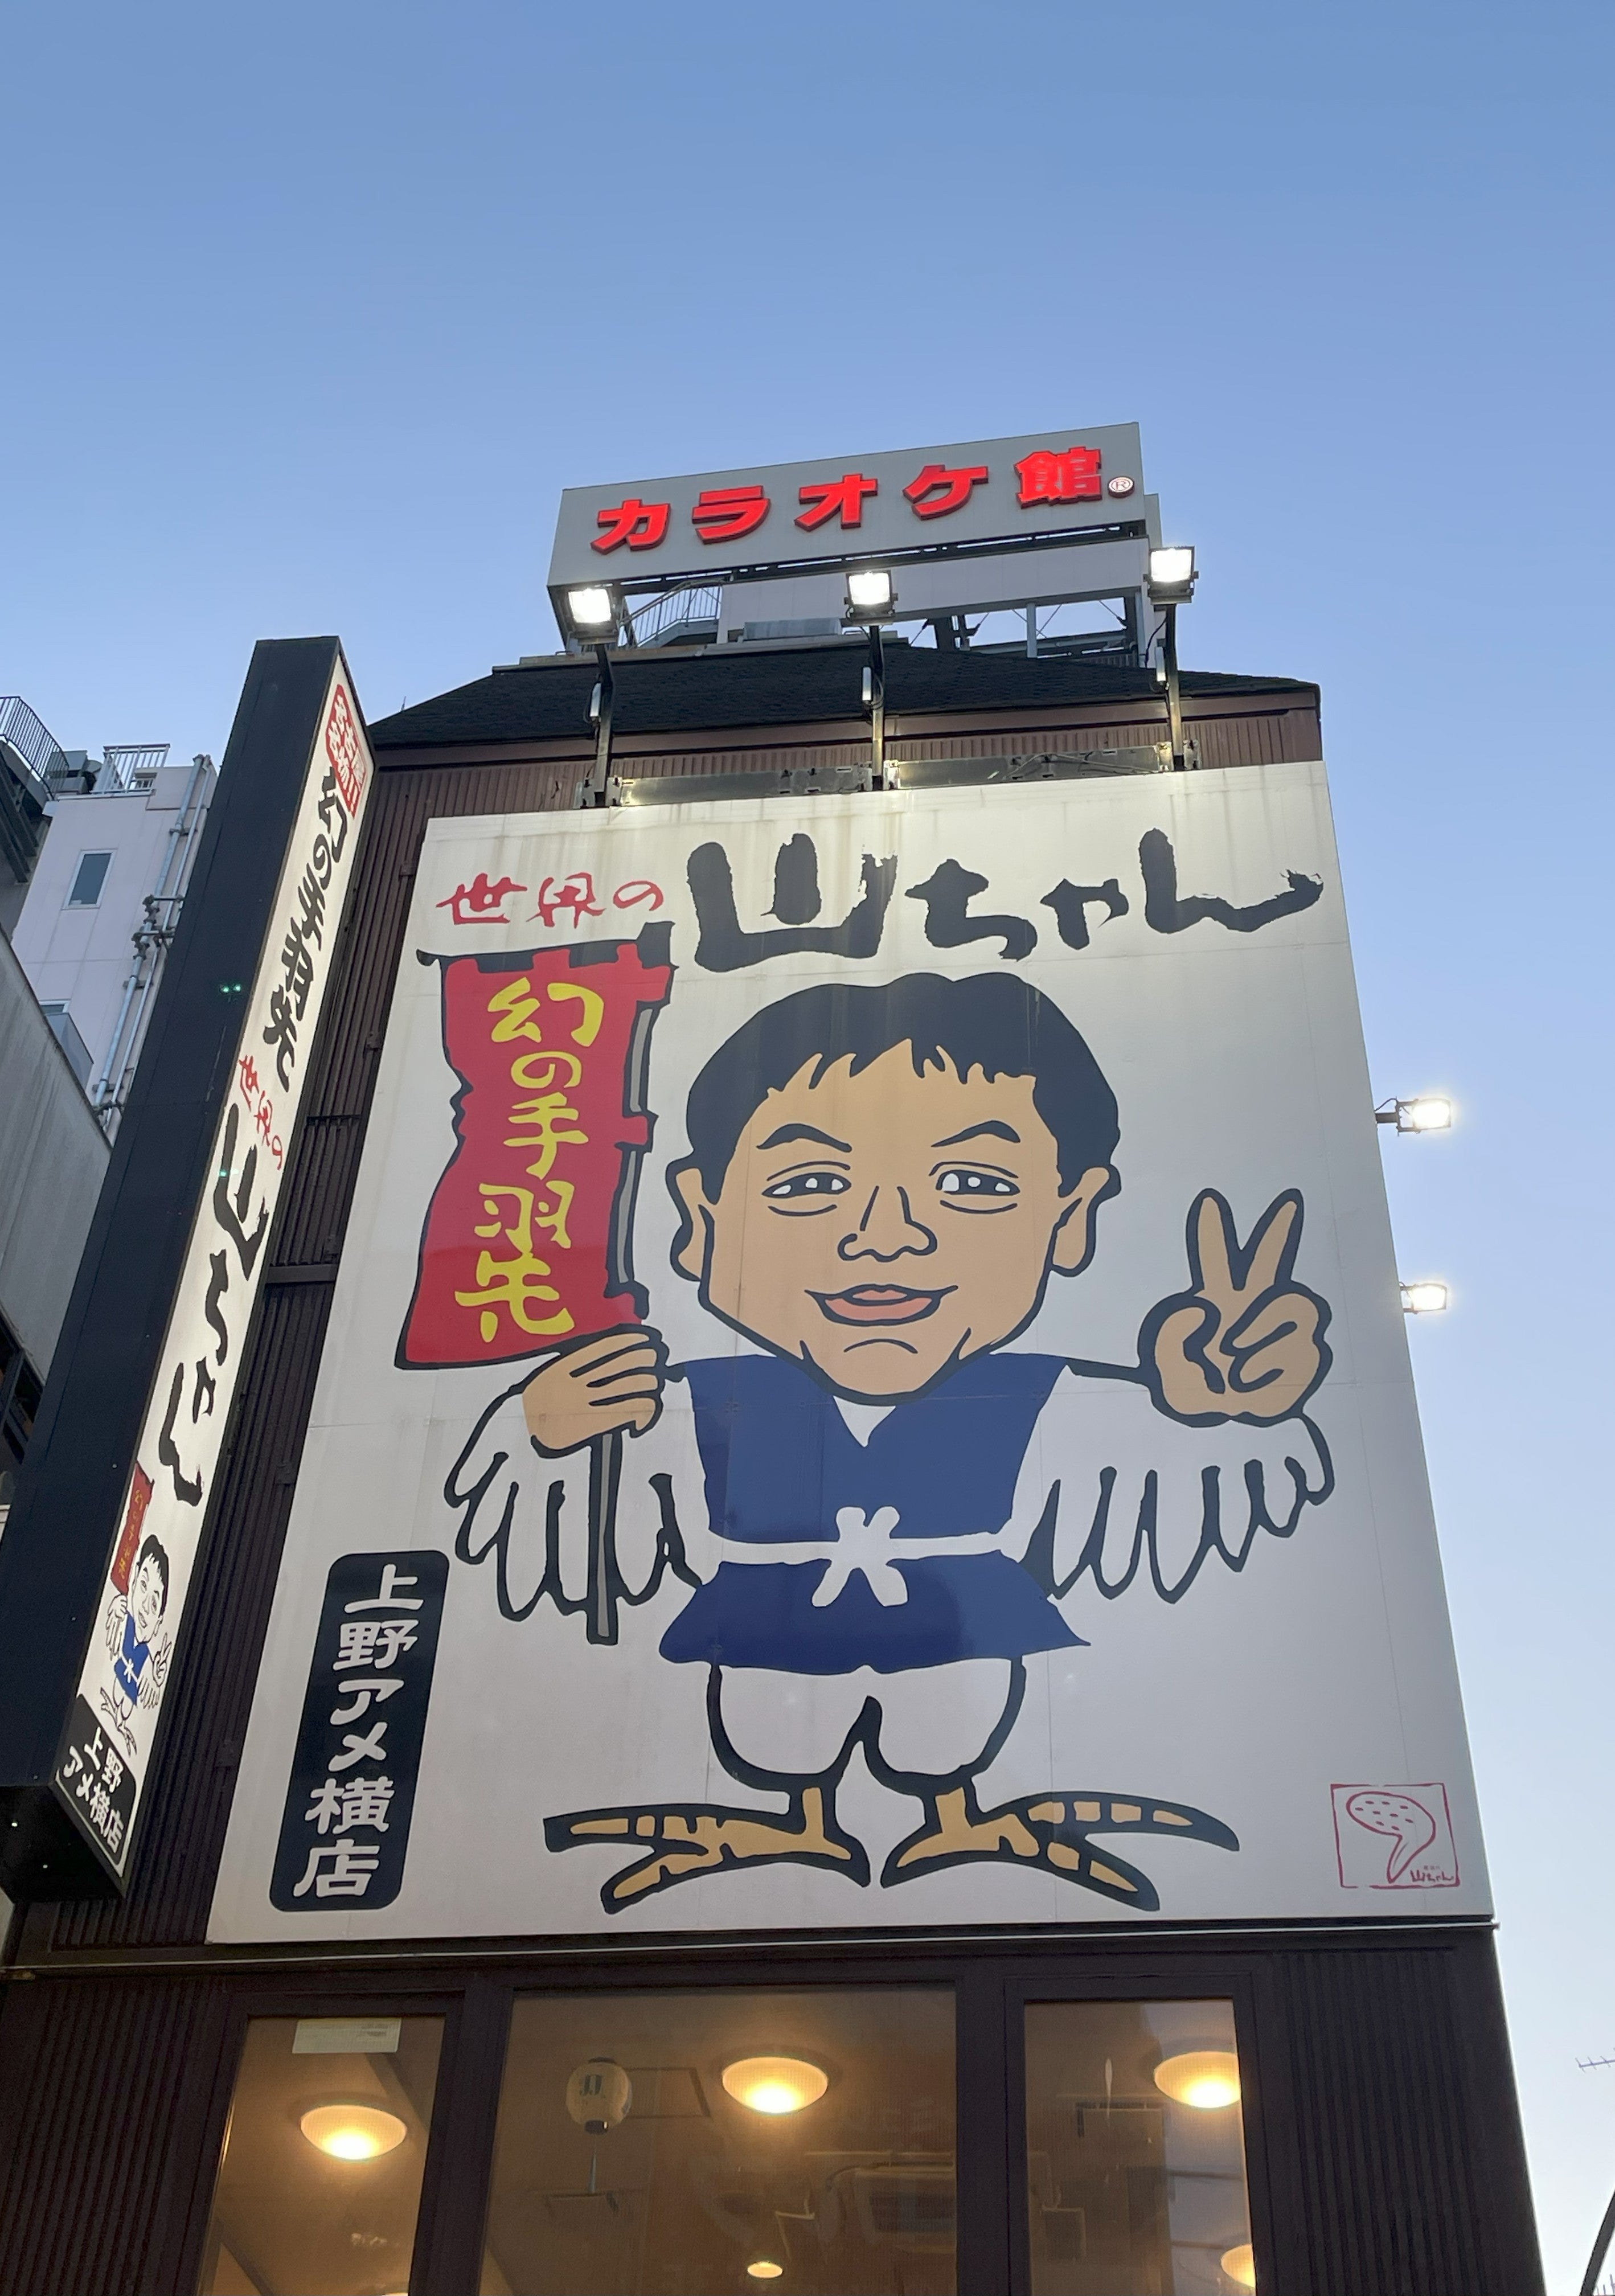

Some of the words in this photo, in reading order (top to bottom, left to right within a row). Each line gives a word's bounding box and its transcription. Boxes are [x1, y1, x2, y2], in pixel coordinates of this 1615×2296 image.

[591, 446, 1102, 554] カラオケ館
[264, 766, 348, 1093] 幻の手羽先
[436, 871, 664, 928] 世界の
[686, 829, 1325, 973] 山ちゃん
[239, 1054, 284, 1170] 世界の
[454, 977, 605, 1343] 幻の手羽先
[158, 1102, 270, 1507] 山ちゃん
[63, 1745, 124, 1854] アメ横店
[84, 1727, 124, 1793] 上野
[293, 1564, 424, 1897] 上野アメ横店
